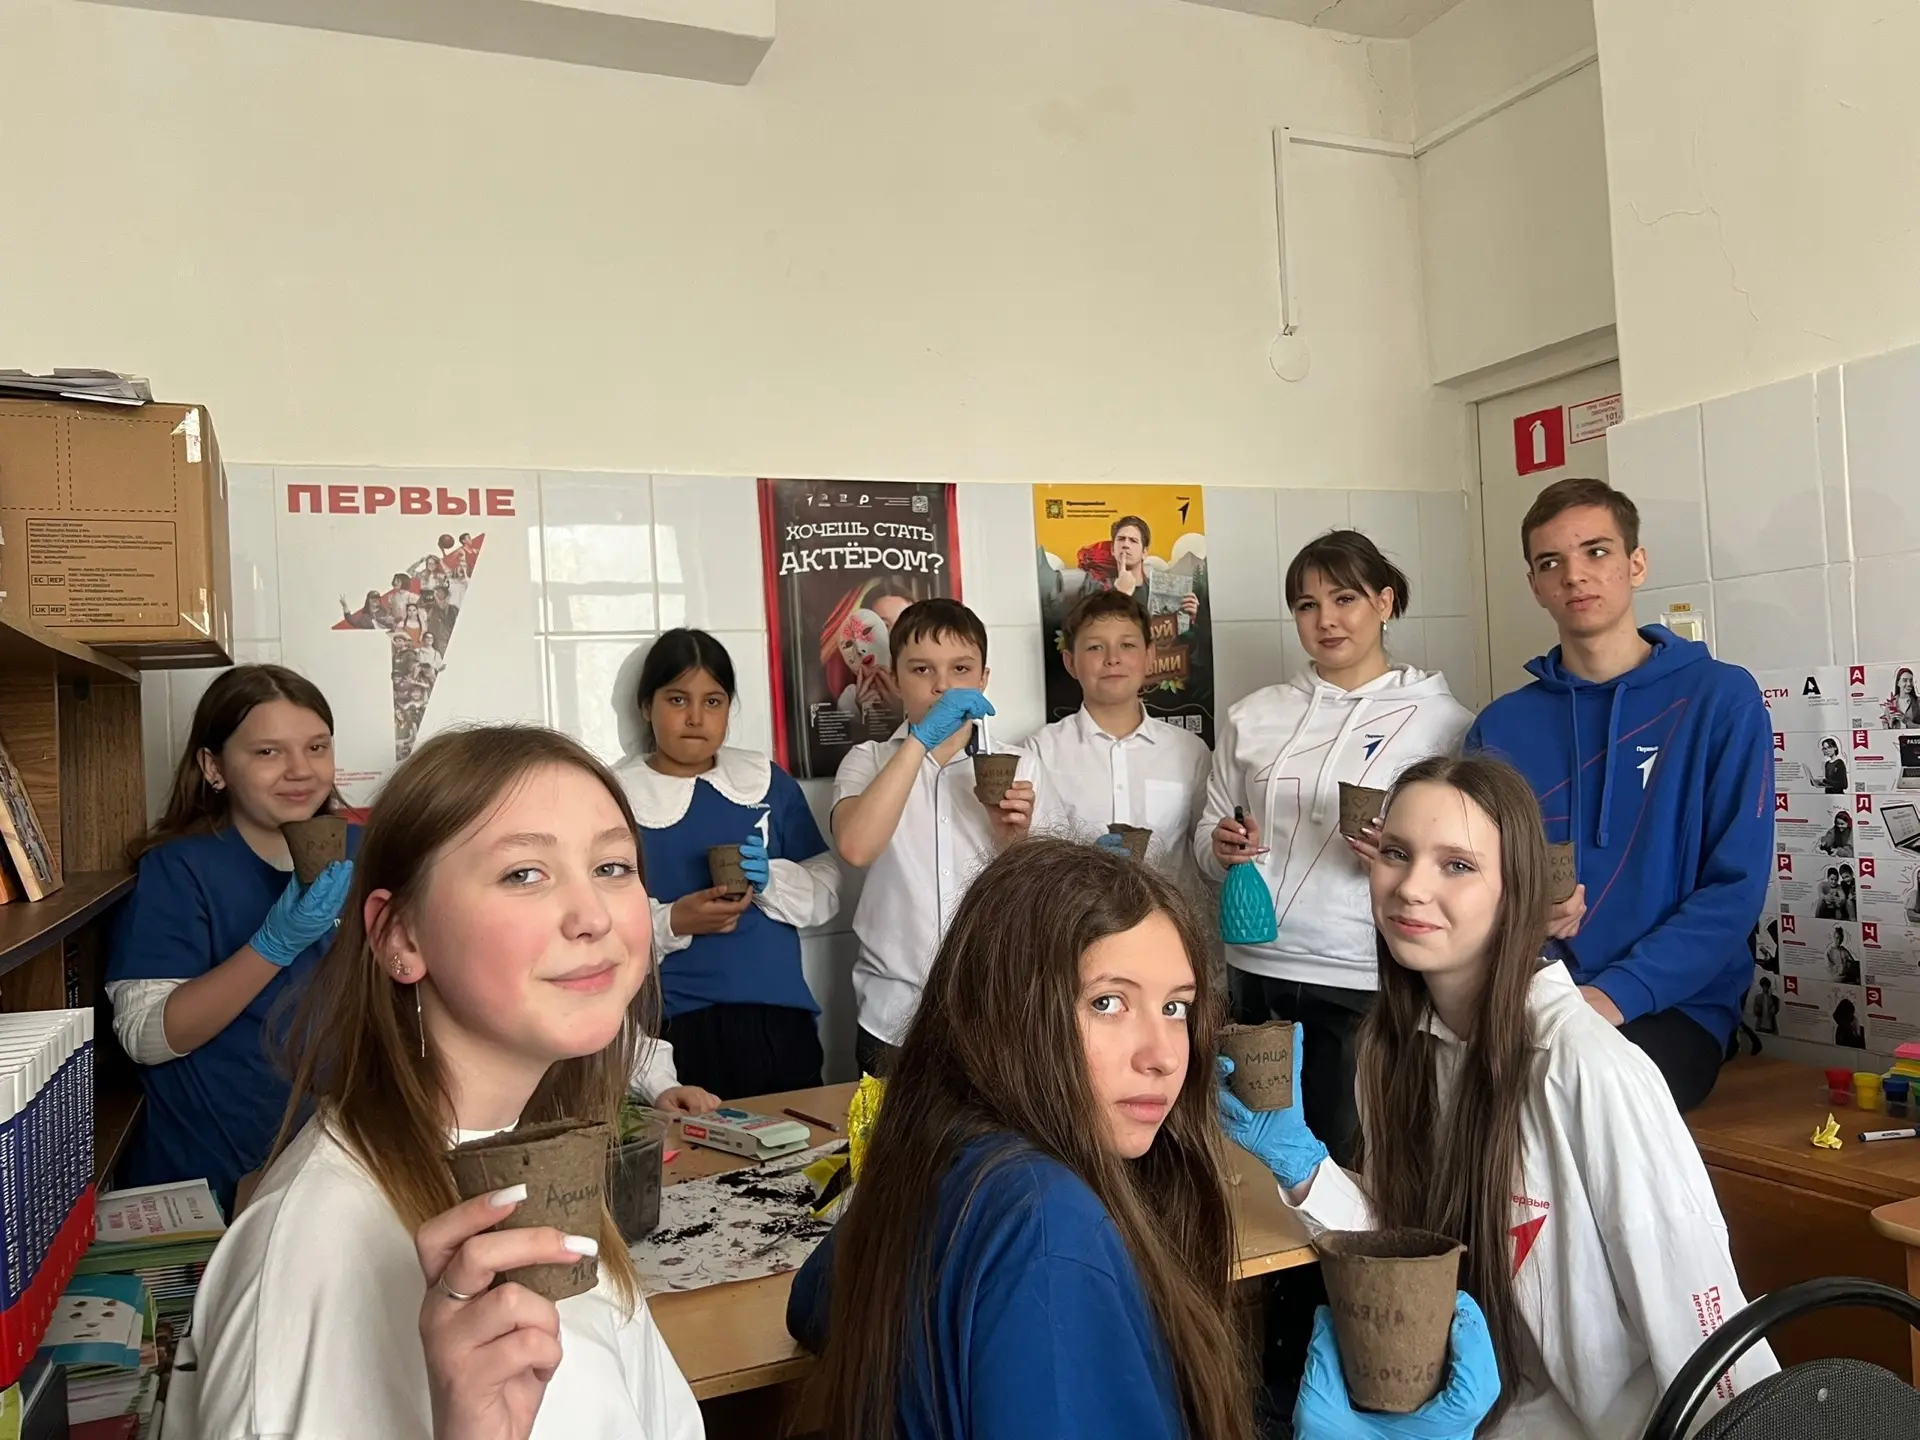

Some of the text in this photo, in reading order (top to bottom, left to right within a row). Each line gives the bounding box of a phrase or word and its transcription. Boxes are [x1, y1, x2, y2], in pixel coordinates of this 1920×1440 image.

[287, 484, 516, 516] ПЕРВЫЕ
[785, 522, 935, 542] ХОЧЕШЬ СТАТЬ
[779, 541, 944, 576] АКТЁРОМ?
[1856, 732, 1866, 744] Ё
[1776, 796, 1786, 807] К
[1858, 797, 1869, 807] Л
[1780, 857, 1789, 867] Р
[1861, 861, 1873, 872] С
[1864, 925, 1875, 937] Ч
[1246, 1048, 1288, 1066] МАША
